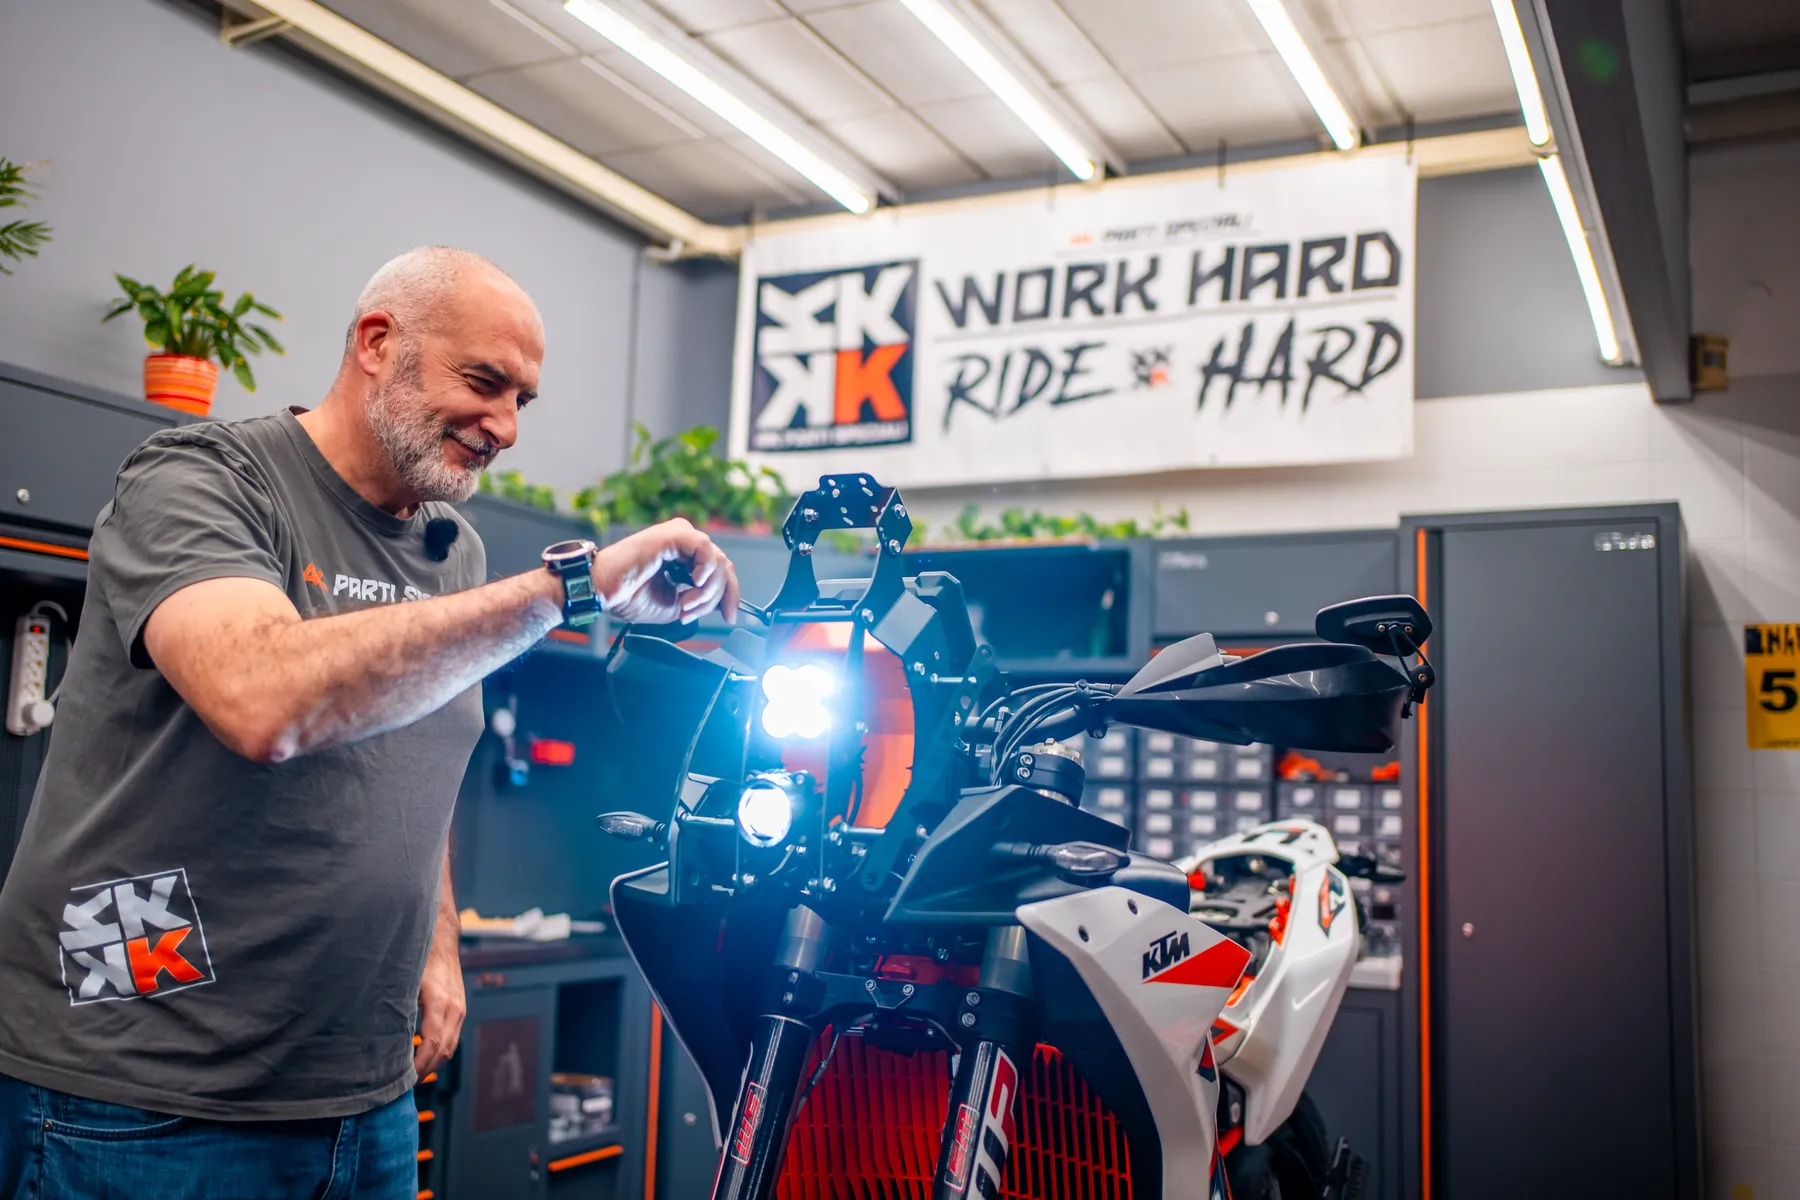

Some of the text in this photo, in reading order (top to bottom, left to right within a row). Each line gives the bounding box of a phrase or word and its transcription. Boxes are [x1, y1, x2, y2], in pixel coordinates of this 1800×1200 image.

[934, 231, 1403, 328] WORK HARD
[941, 316, 1404, 433] RIDE HARD
[333, 573, 396, 604] PARTI
[1142, 930, 1191, 980] KTM
